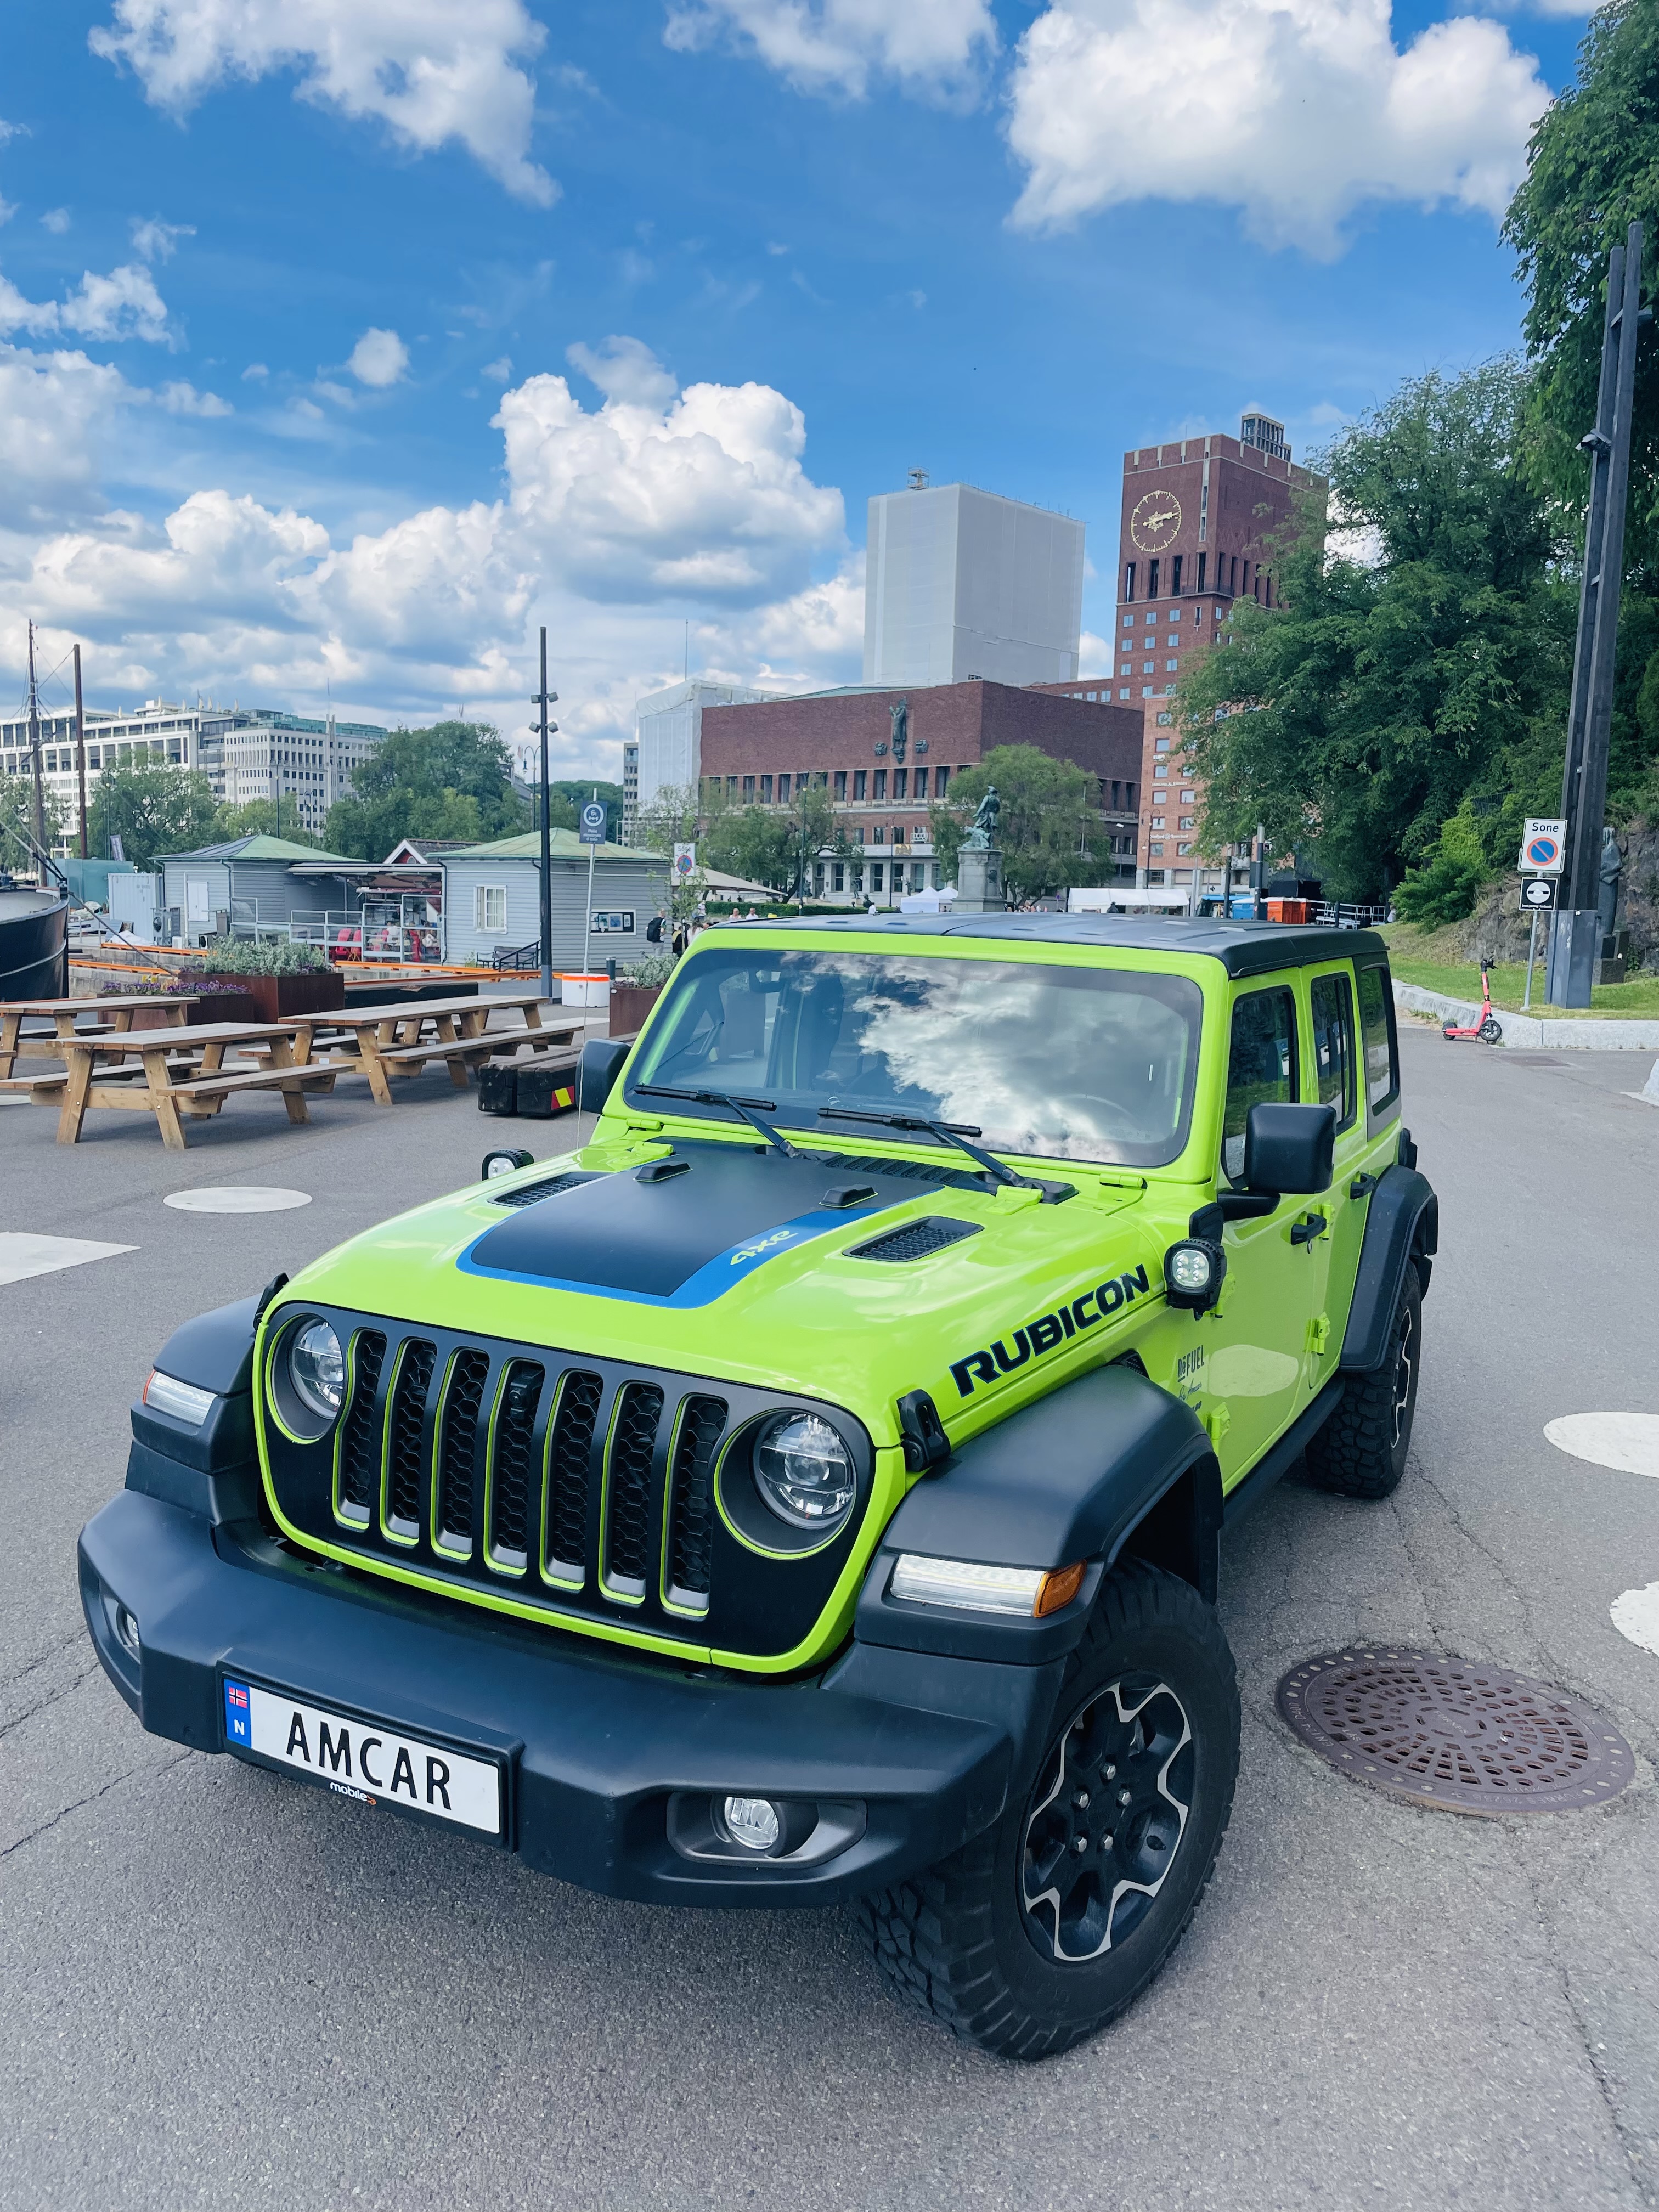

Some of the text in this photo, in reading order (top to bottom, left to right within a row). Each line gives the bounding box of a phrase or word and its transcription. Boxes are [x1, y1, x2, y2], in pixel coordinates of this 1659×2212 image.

[1532, 822, 1559, 832] Sone
[949, 1263, 1149, 1398] RUBICON
[234, 1719, 245, 1736] N
[286, 1711, 452, 1810] AMCAR
